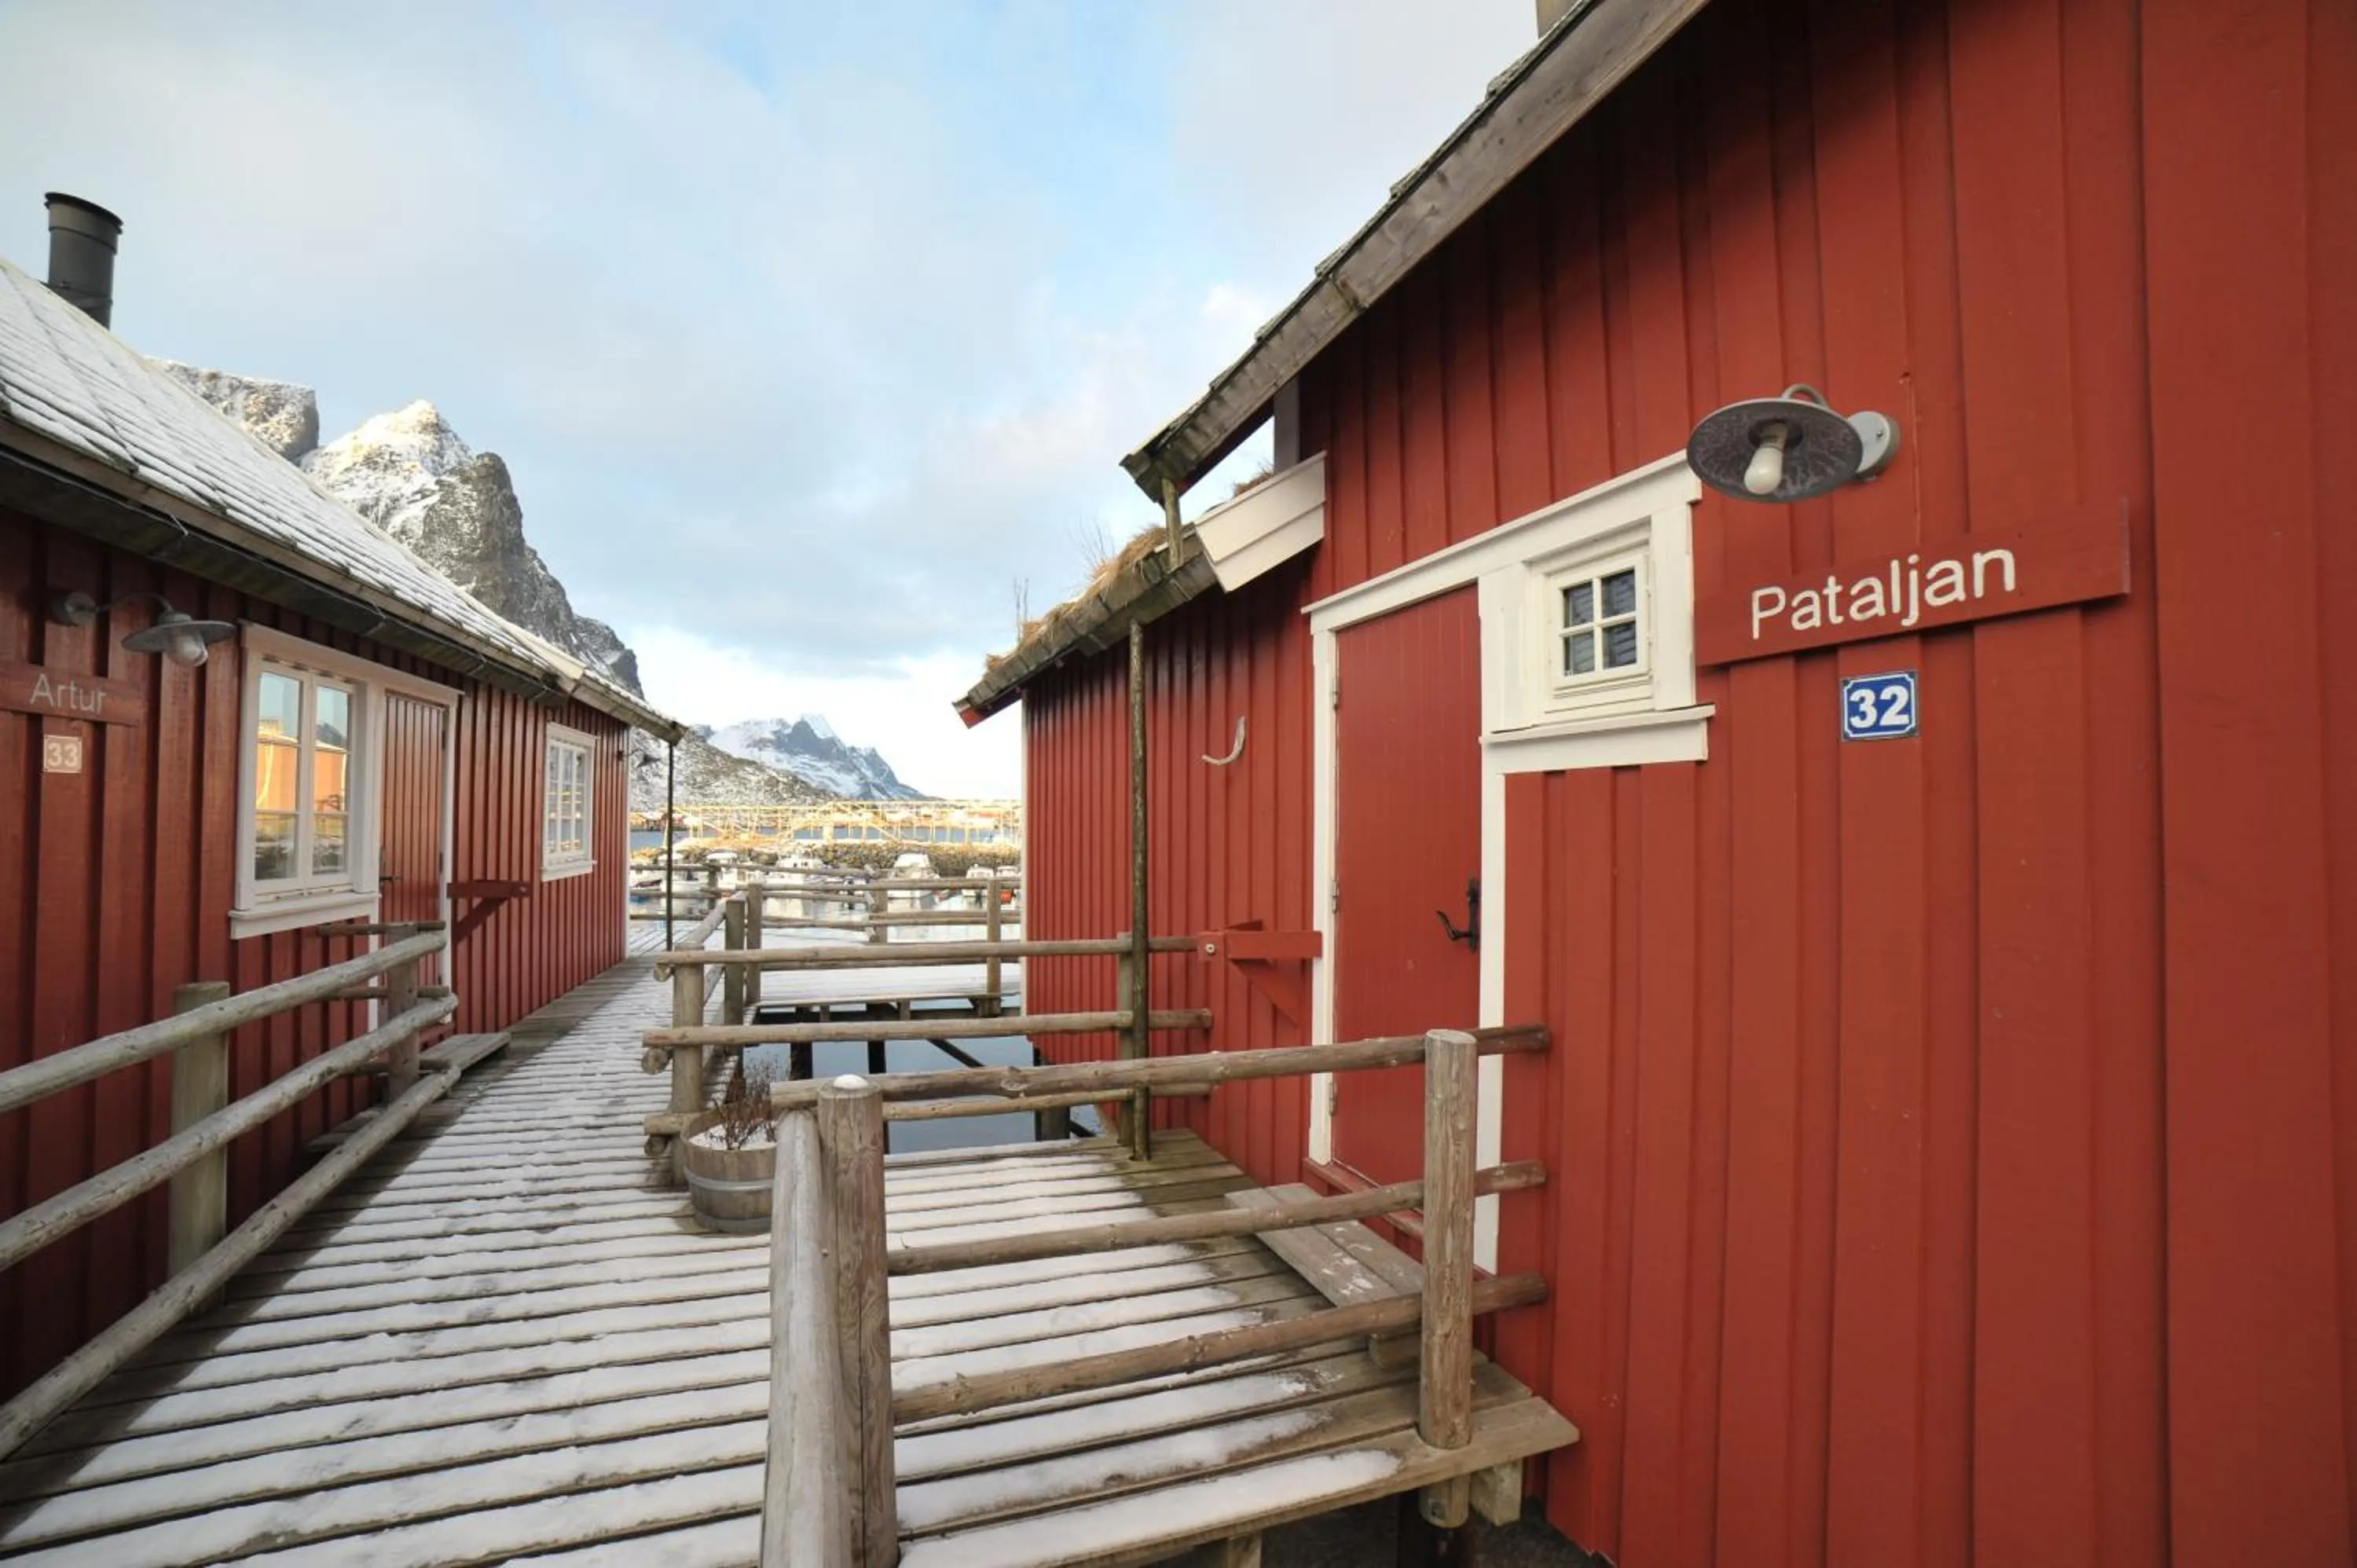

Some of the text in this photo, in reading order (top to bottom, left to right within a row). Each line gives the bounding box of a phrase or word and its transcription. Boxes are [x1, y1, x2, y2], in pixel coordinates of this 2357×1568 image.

[1751, 548, 2017, 640] Pataljan
[29, 672, 107, 714] Artur
[1848, 685, 1911, 729] 32
[46, 742, 79, 768] 33
